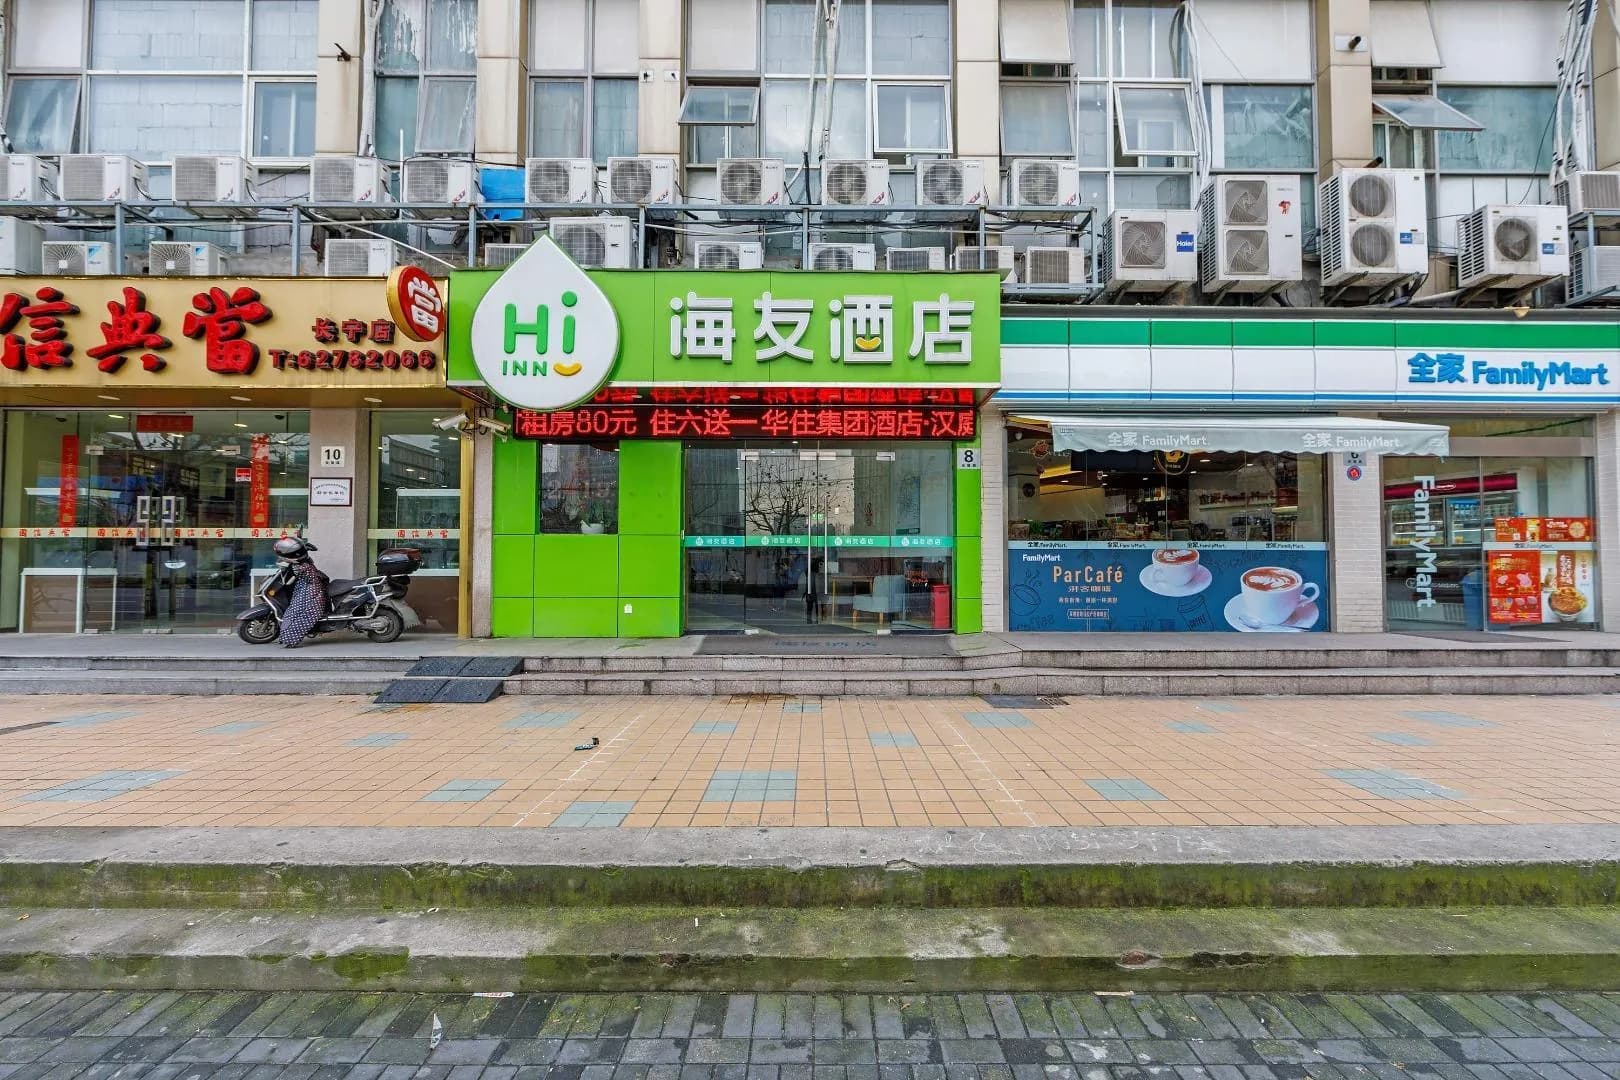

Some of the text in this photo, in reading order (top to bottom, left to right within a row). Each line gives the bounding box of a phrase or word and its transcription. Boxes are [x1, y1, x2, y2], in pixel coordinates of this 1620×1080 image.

[312, 318, 395, 343] 长宁店
[504, 290, 578, 355] Hi
[670, 291, 975, 364] 海友酒店
[502, 360, 548, 377] INN
[1407, 352, 1609, 391] 全家 FamilyMart
[515, 408, 637, 437] 租房80元
[1107, 431, 1208, 449] 全家 FamilyMart
[1302, 433, 1400, 448] 全家 FamilyMart
[324, 449, 341, 460] 10
[964, 450, 974, 462] 8
[1410, 475, 1437, 607] FamilyMart
[1022, 554, 1061, 564] FamilyMart
[1053, 565, 1124, 583] ParCafé
